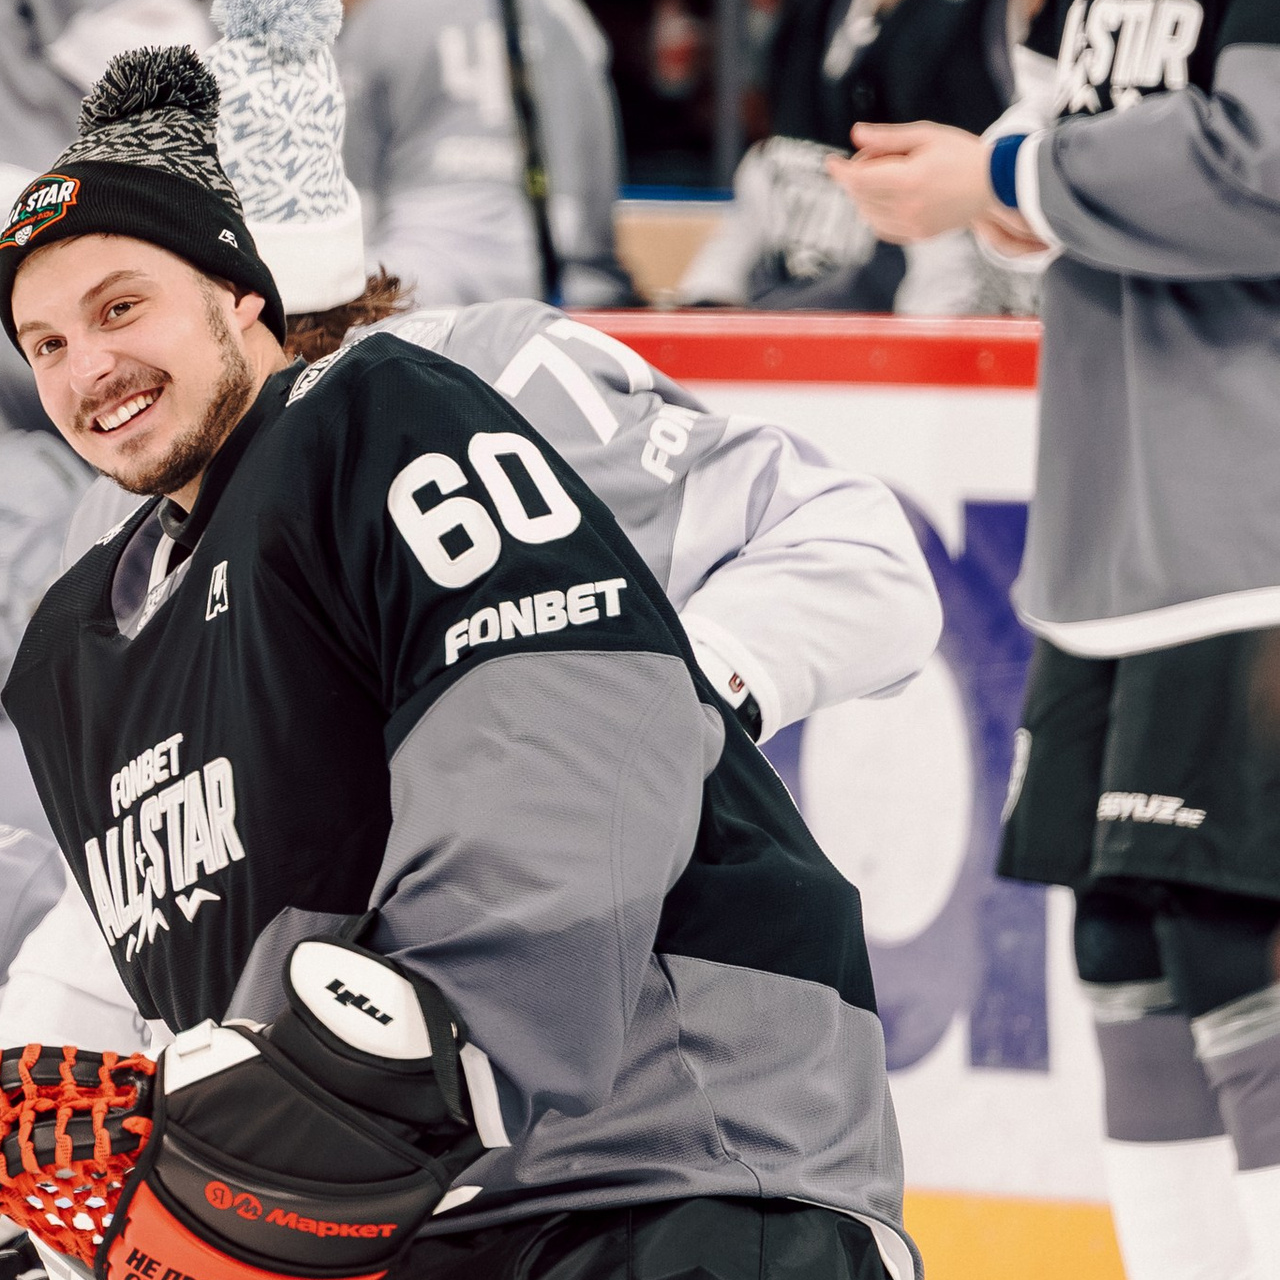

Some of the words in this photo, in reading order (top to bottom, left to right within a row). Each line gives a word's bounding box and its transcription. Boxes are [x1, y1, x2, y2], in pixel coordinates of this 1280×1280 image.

[26, 181, 76, 212] STAR
[388, 431, 582, 589] 60
[444, 577, 628, 666] FONBET
[110, 732, 184, 818] FONBET
[265, 1207, 398, 1238] Маркет
[125, 1247, 161, 1274] НЕ
